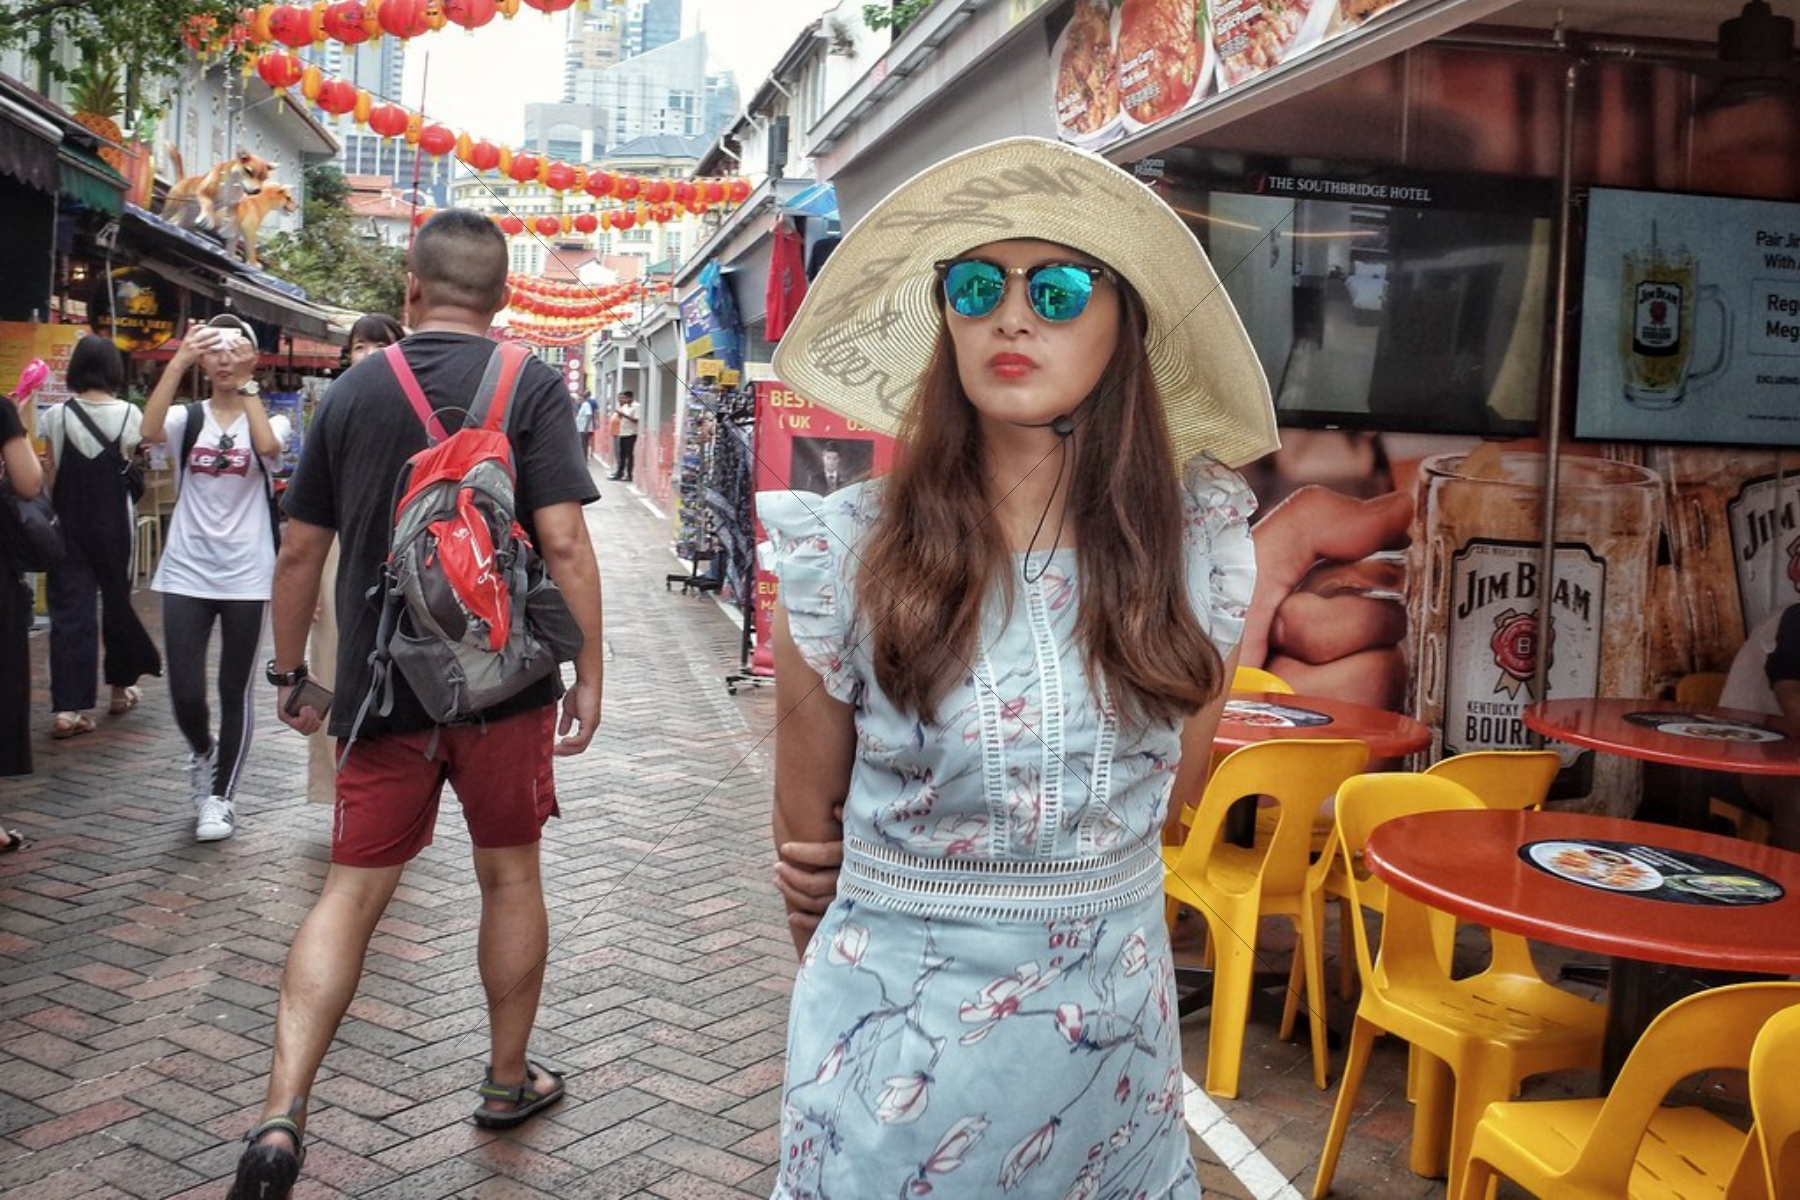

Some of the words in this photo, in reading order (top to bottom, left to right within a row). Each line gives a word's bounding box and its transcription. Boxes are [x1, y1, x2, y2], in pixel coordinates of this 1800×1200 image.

[1269, 176, 1294, 191] THE
[1297, 178, 1387, 198] SOUTHBRIDGE
[1390, 187, 1432, 202] HOTEL
[1756, 231, 1785, 246] Pair
[1763, 253, 1796, 269] With
[1766, 294, 1800, 317] Reg
[1766, 319, 1800, 343] Meg
[1458, 569, 1511, 620] JIM
[1515, 561, 1592, 623] BAM
[1466, 700, 1520, 716] KENTUCKY
[1466, 715, 1563, 745] BOUR
